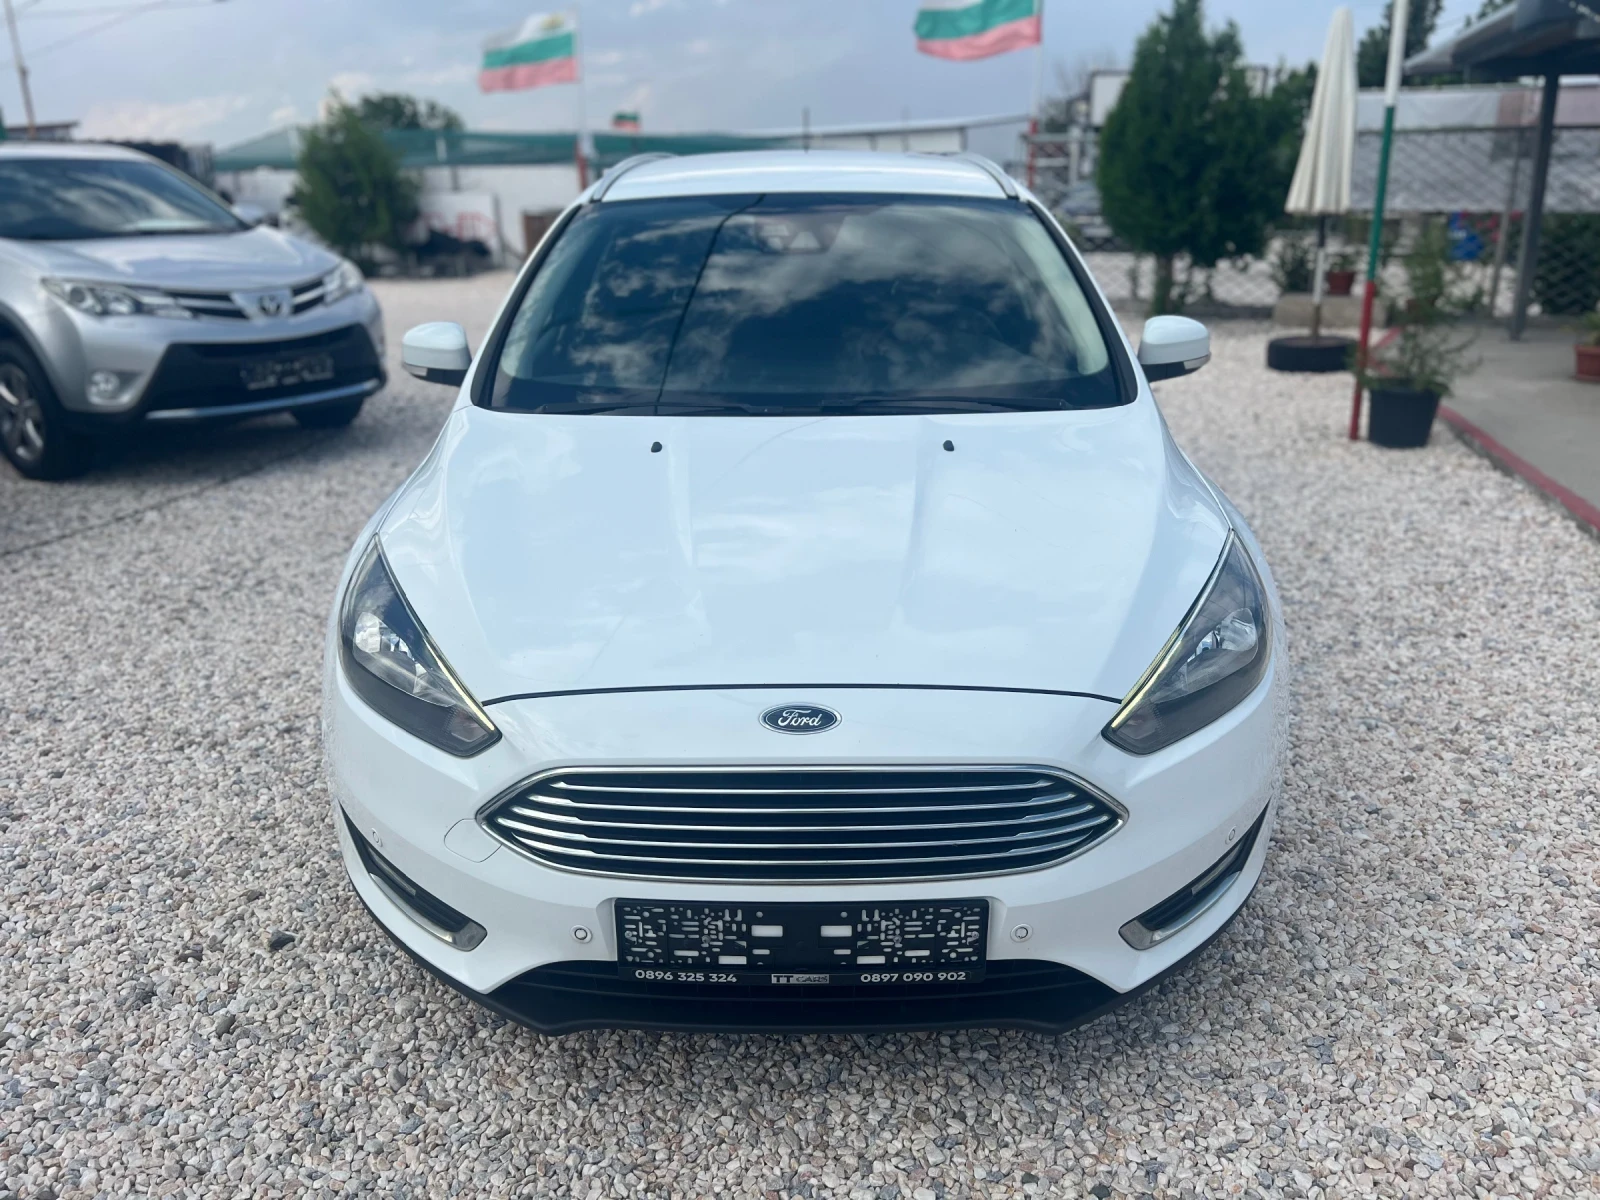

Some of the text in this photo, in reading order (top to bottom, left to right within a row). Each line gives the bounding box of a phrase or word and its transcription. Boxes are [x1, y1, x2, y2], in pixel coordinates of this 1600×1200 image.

[778, 709, 822, 726] Ford
[635, 969, 738, 983] 0896 325 324
[773, 974, 794, 983] TT
[860, 971, 967, 983] 0897 090 902
